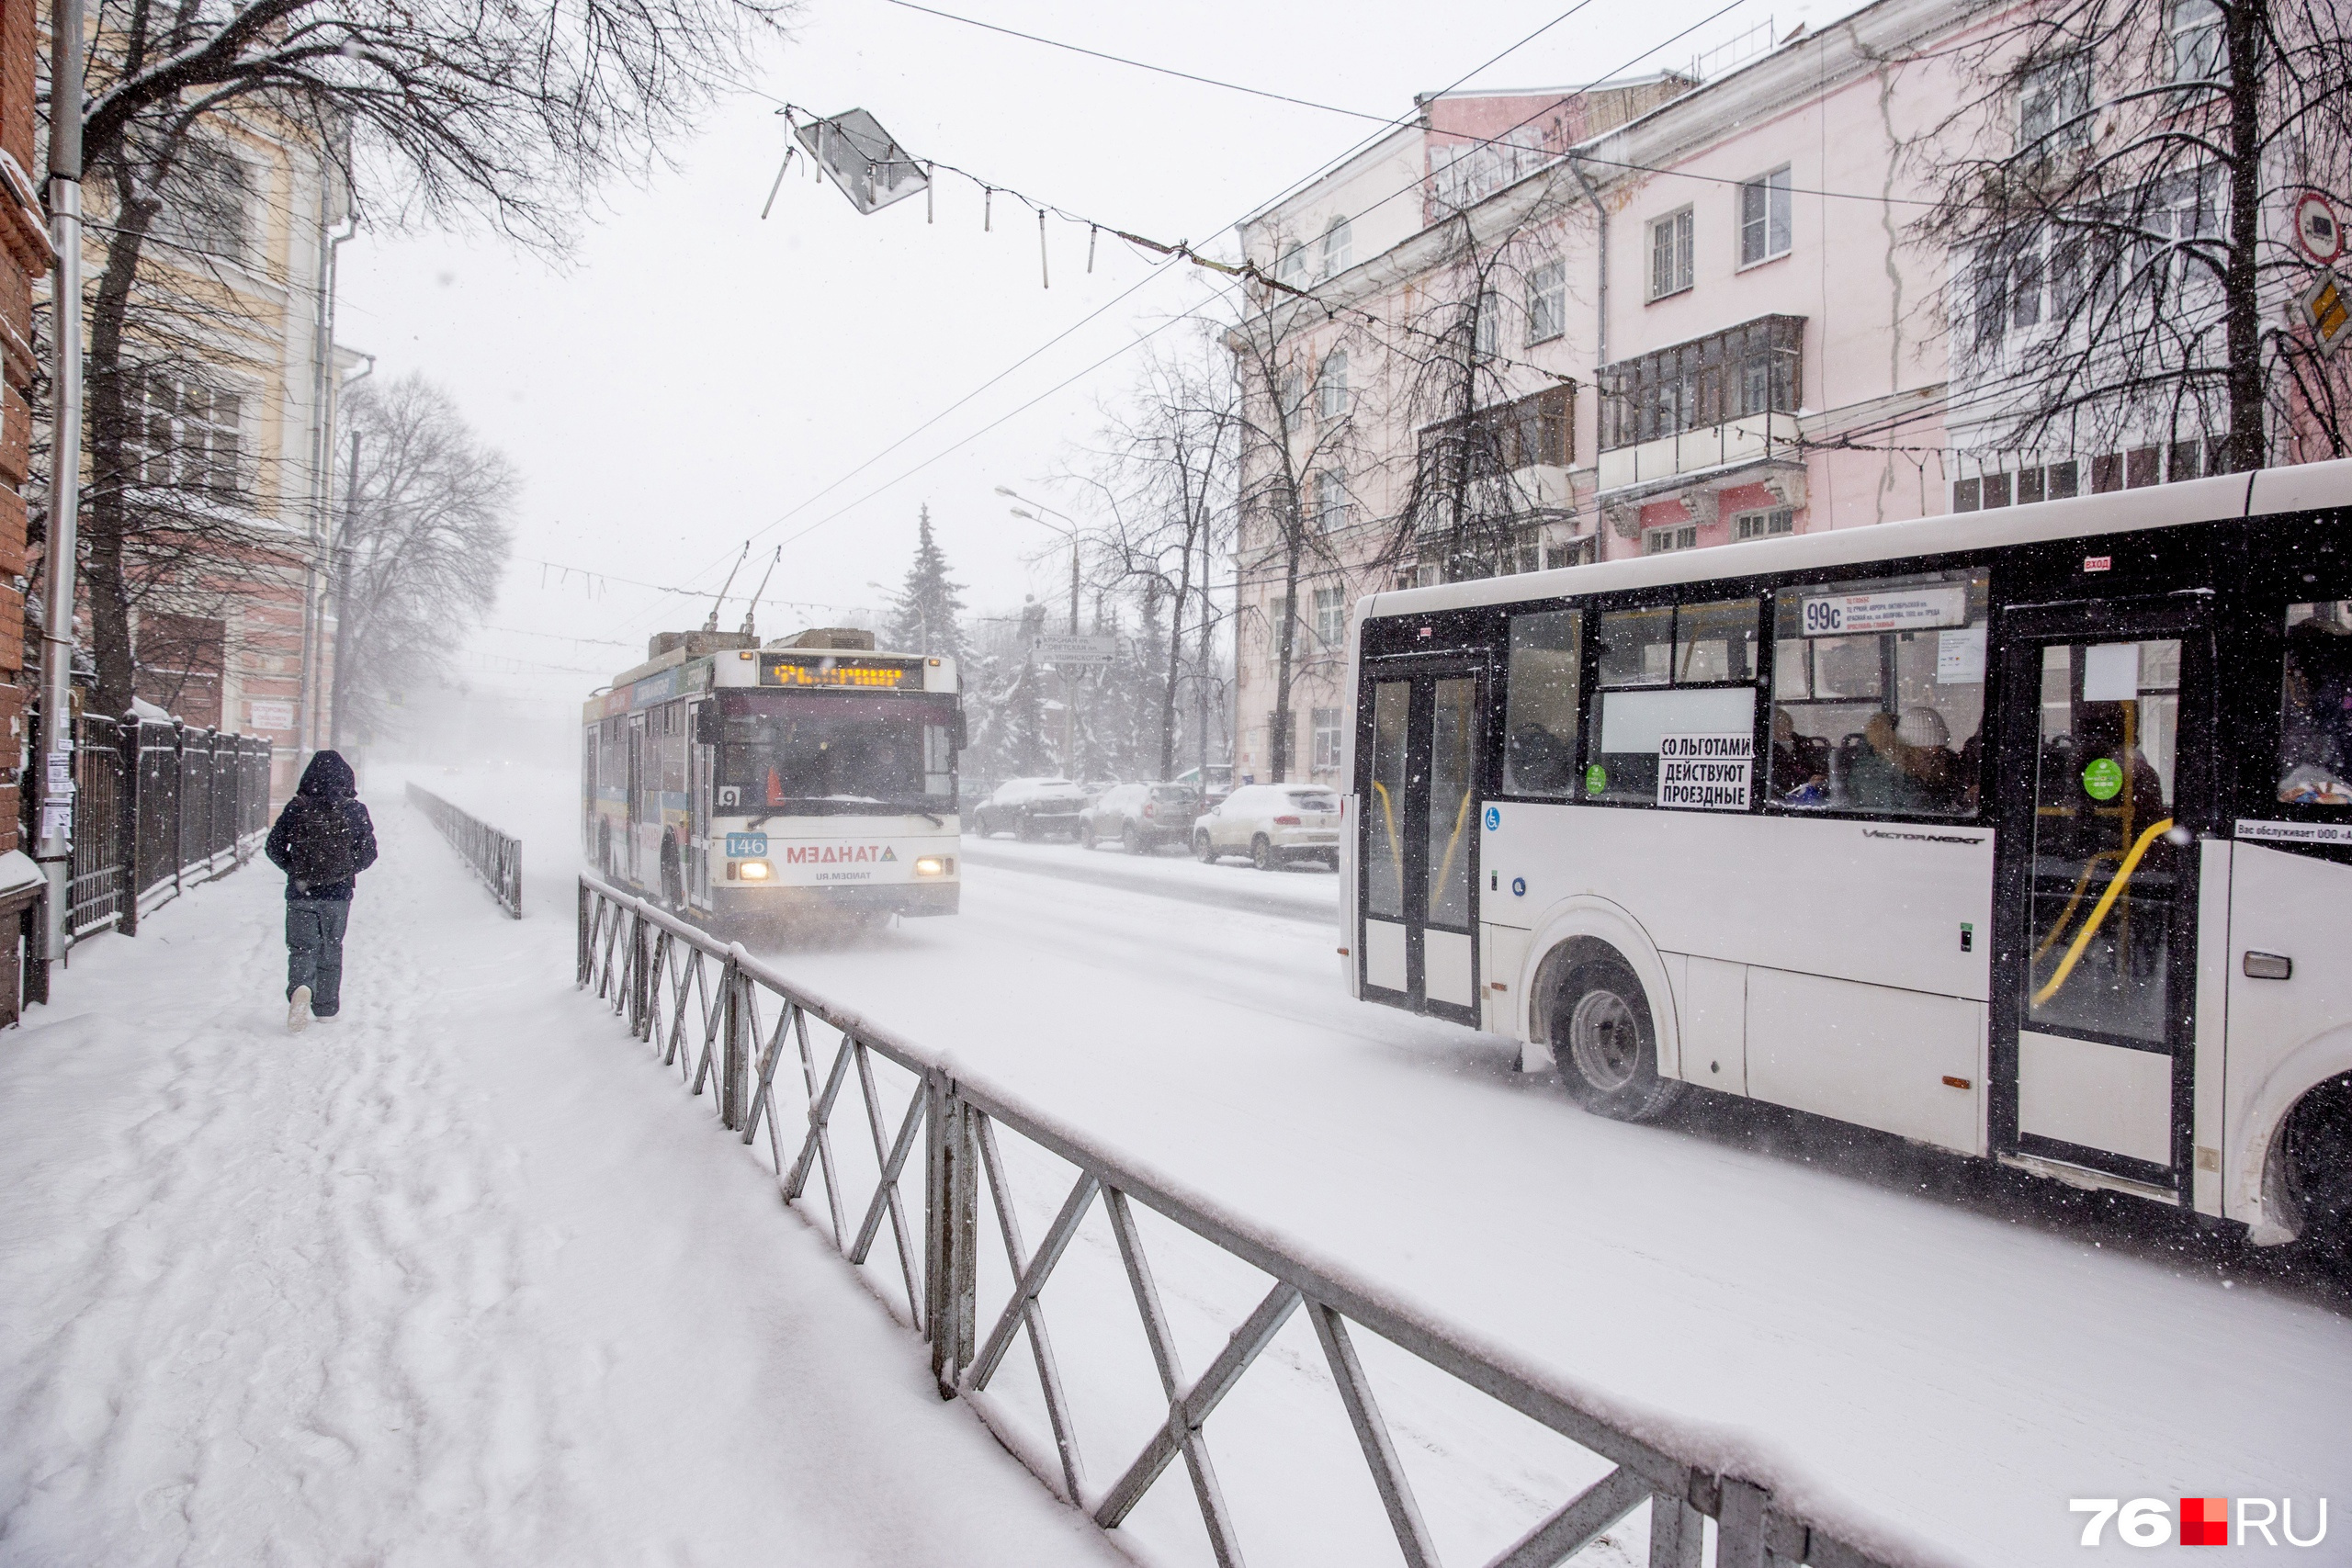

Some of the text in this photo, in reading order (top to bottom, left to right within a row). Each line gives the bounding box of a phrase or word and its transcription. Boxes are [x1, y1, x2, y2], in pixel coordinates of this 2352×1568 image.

[2086, 559, 2109, 570] ВХОД
[1662, 739, 1750, 755] СО ЛЬГОТАМИ
[1665, 761, 1745, 784] ДЕЙСТВУЮТ
[723, 789, 737, 806] 9
[1663, 785, 1745, 807] ПРОЕЗДНЫЕ
[2238, 825, 2255, 835] Вас
[2256, 826, 2315, 838] обслуживает
[2317, 829, 2338, 839] ООО
[730, 839, 766, 854] 146
